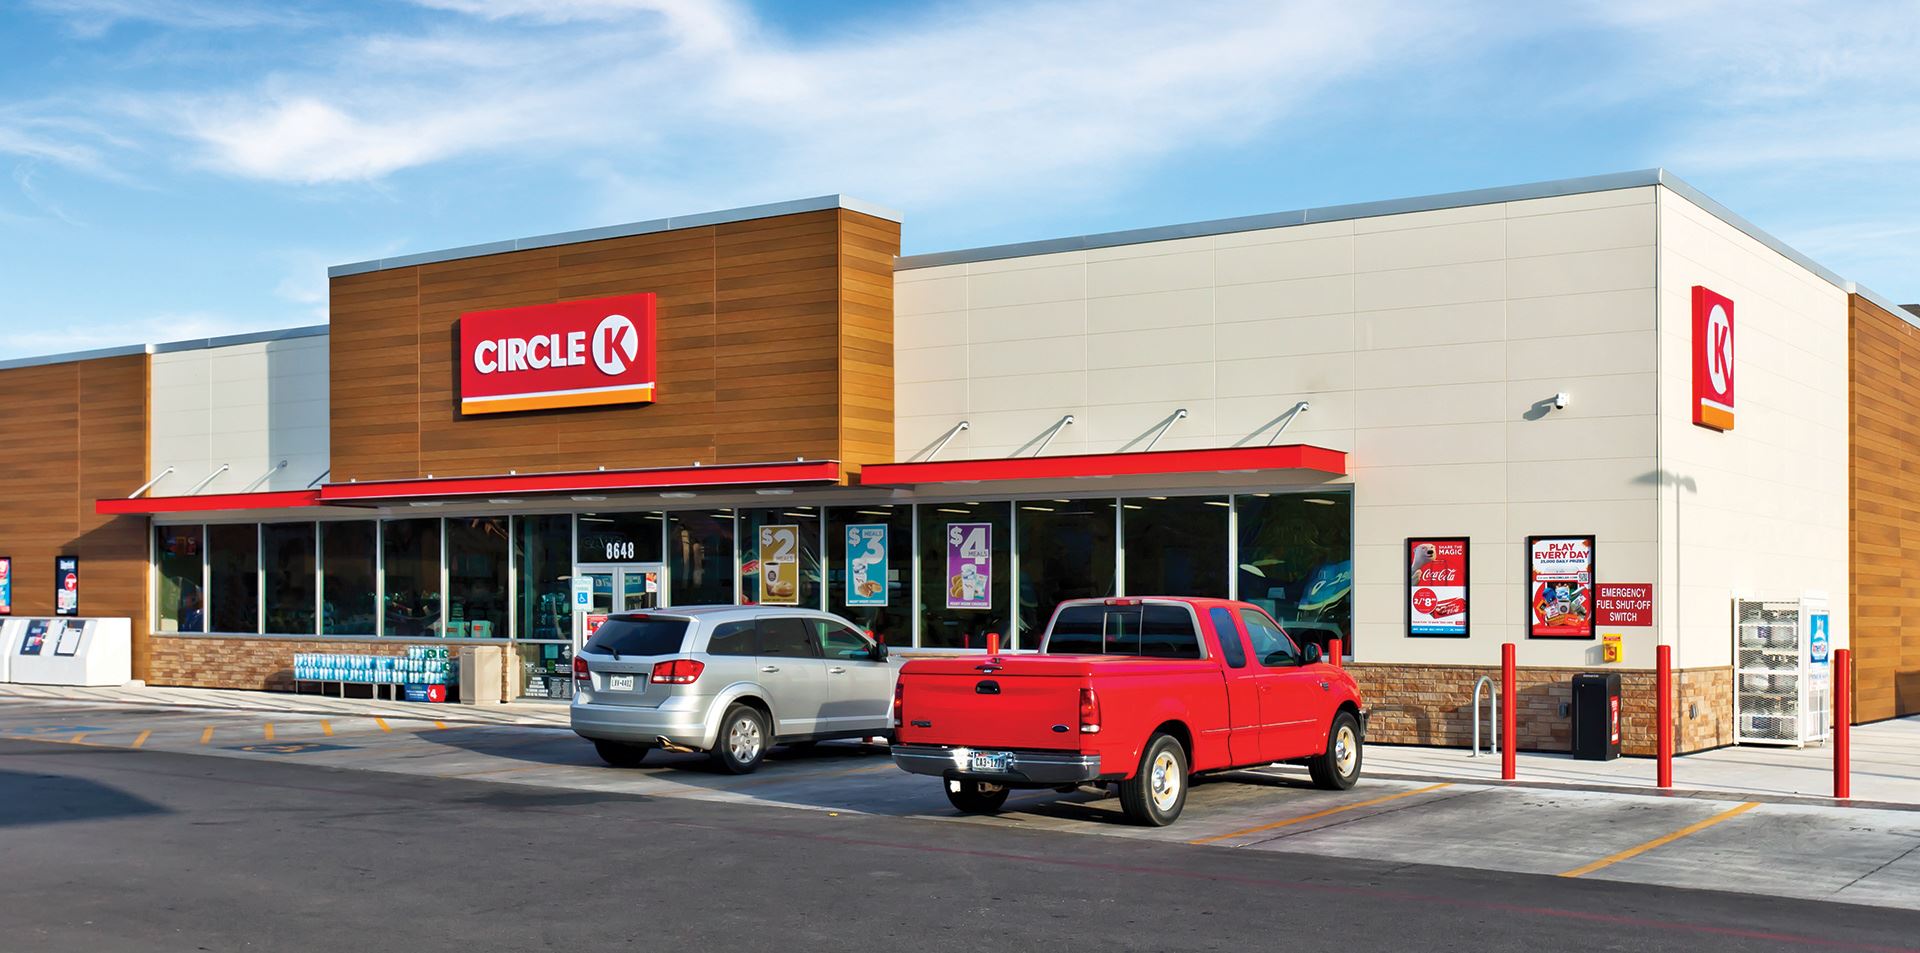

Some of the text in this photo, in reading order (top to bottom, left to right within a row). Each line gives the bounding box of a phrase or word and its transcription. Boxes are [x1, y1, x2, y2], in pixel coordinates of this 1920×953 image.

[474, 319, 636, 374] CIRCLE K
[606, 542, 634, 559] 8648
[950, 527, 986, 564] $4
[1549, 543, 1575, 551] PLAY
[1535, 551, 1589, 559] EVERY DAY
[1601, 587, 1646, 597] EMERGENCY
[1596, 600, 1651, 610] FUEL SHUT-OFF
[1610, 611, 1637, 622] SWITCH
